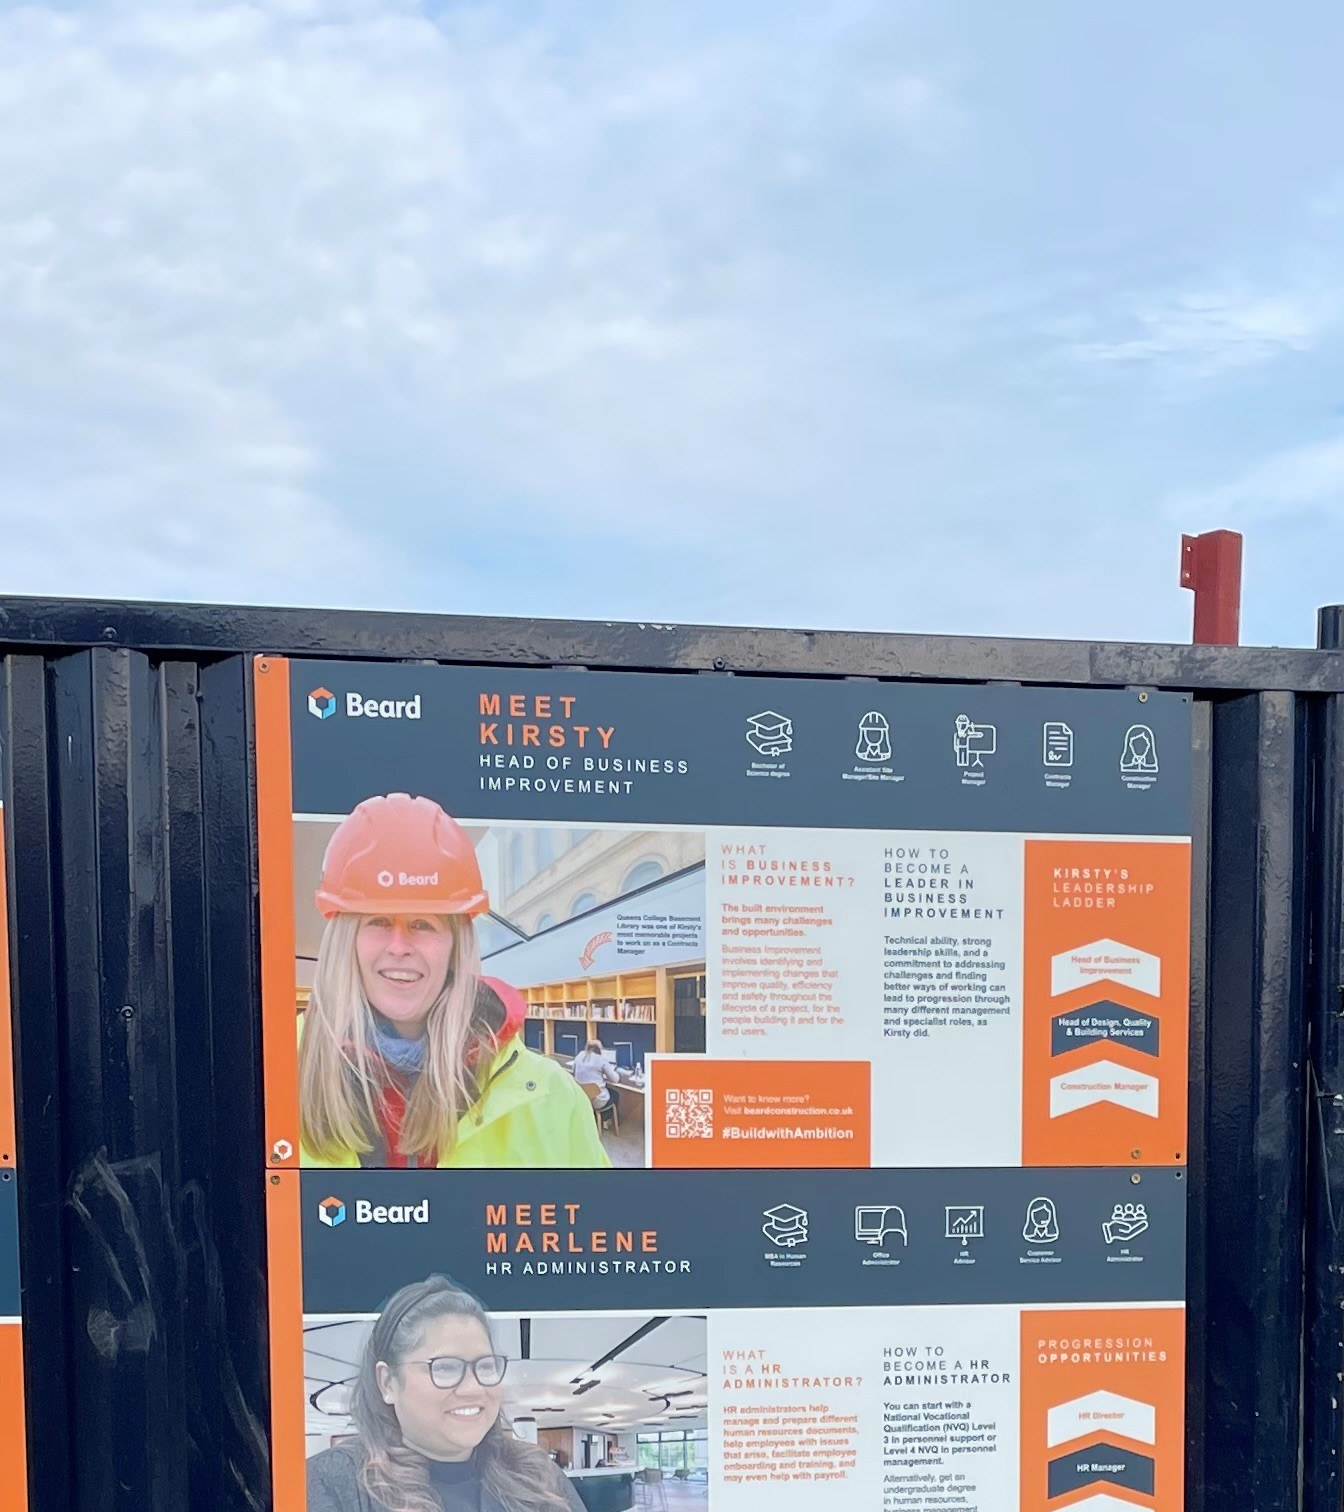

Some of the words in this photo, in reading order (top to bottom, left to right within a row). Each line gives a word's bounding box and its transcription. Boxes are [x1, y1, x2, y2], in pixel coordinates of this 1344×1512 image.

[345, 693, 420, 719] Beard
[480, 694, 576, 718] MEET
[481, 723, 614, 748] KIRSTY
[479, 755, 535, 768] HEAD
[547, 756, 571, 769] OF
[584, 758, 687, 773] BUSINESS
[481, 777, 633, 794] IMPROVEMENT
[721, 845, 766, 855] WHAT
[722, 860, 736, 870] IS
[746, 860, 831, 872] BUSINESS
[398, 872, 438, 885] Beard
[1054, 868, 1128, 879] KIRSTY'S
[722, 875, 854, 887] IMPROVEMENT?
[1053, 882, 1154, 894] LEADERSHIP
[1053, 897, 1115, 908] LADDER
[884, 935, 927, 945] Technical
[930, 936, 958, 947] ability,
[962, 937, 991, 947] strong
[722, 1127, 853, 1139] #BuildwithAmbition
[355, 1199, 428, 1224] Beard
[487, 1204, 580, 1225] MEET
[487, 1231, 657, 1253] MARLENE
[487, 1262, 511, 1274] HR
[523, 1260, 690, 1275] ADMINISTRATOR
[1038, 1337, 1152, 1349] PROGRESSION
[883, 1347, 917, 1357] HOW
[925, 1346, 944, 1356] TO
[1038, 1351, 1166, 1364] OPPORTUNITIES
[883, 1361, 946, 1372] BECOME
[954, 1360, 962, 1370] A
[970, 1360, 989, 1369] HR
[883, 1373, 1010, 1386] ADMINISTRATOR
[1077, 1464, 1089, 1472] HR
[1090, 1464, 1125, 1473] Manager
